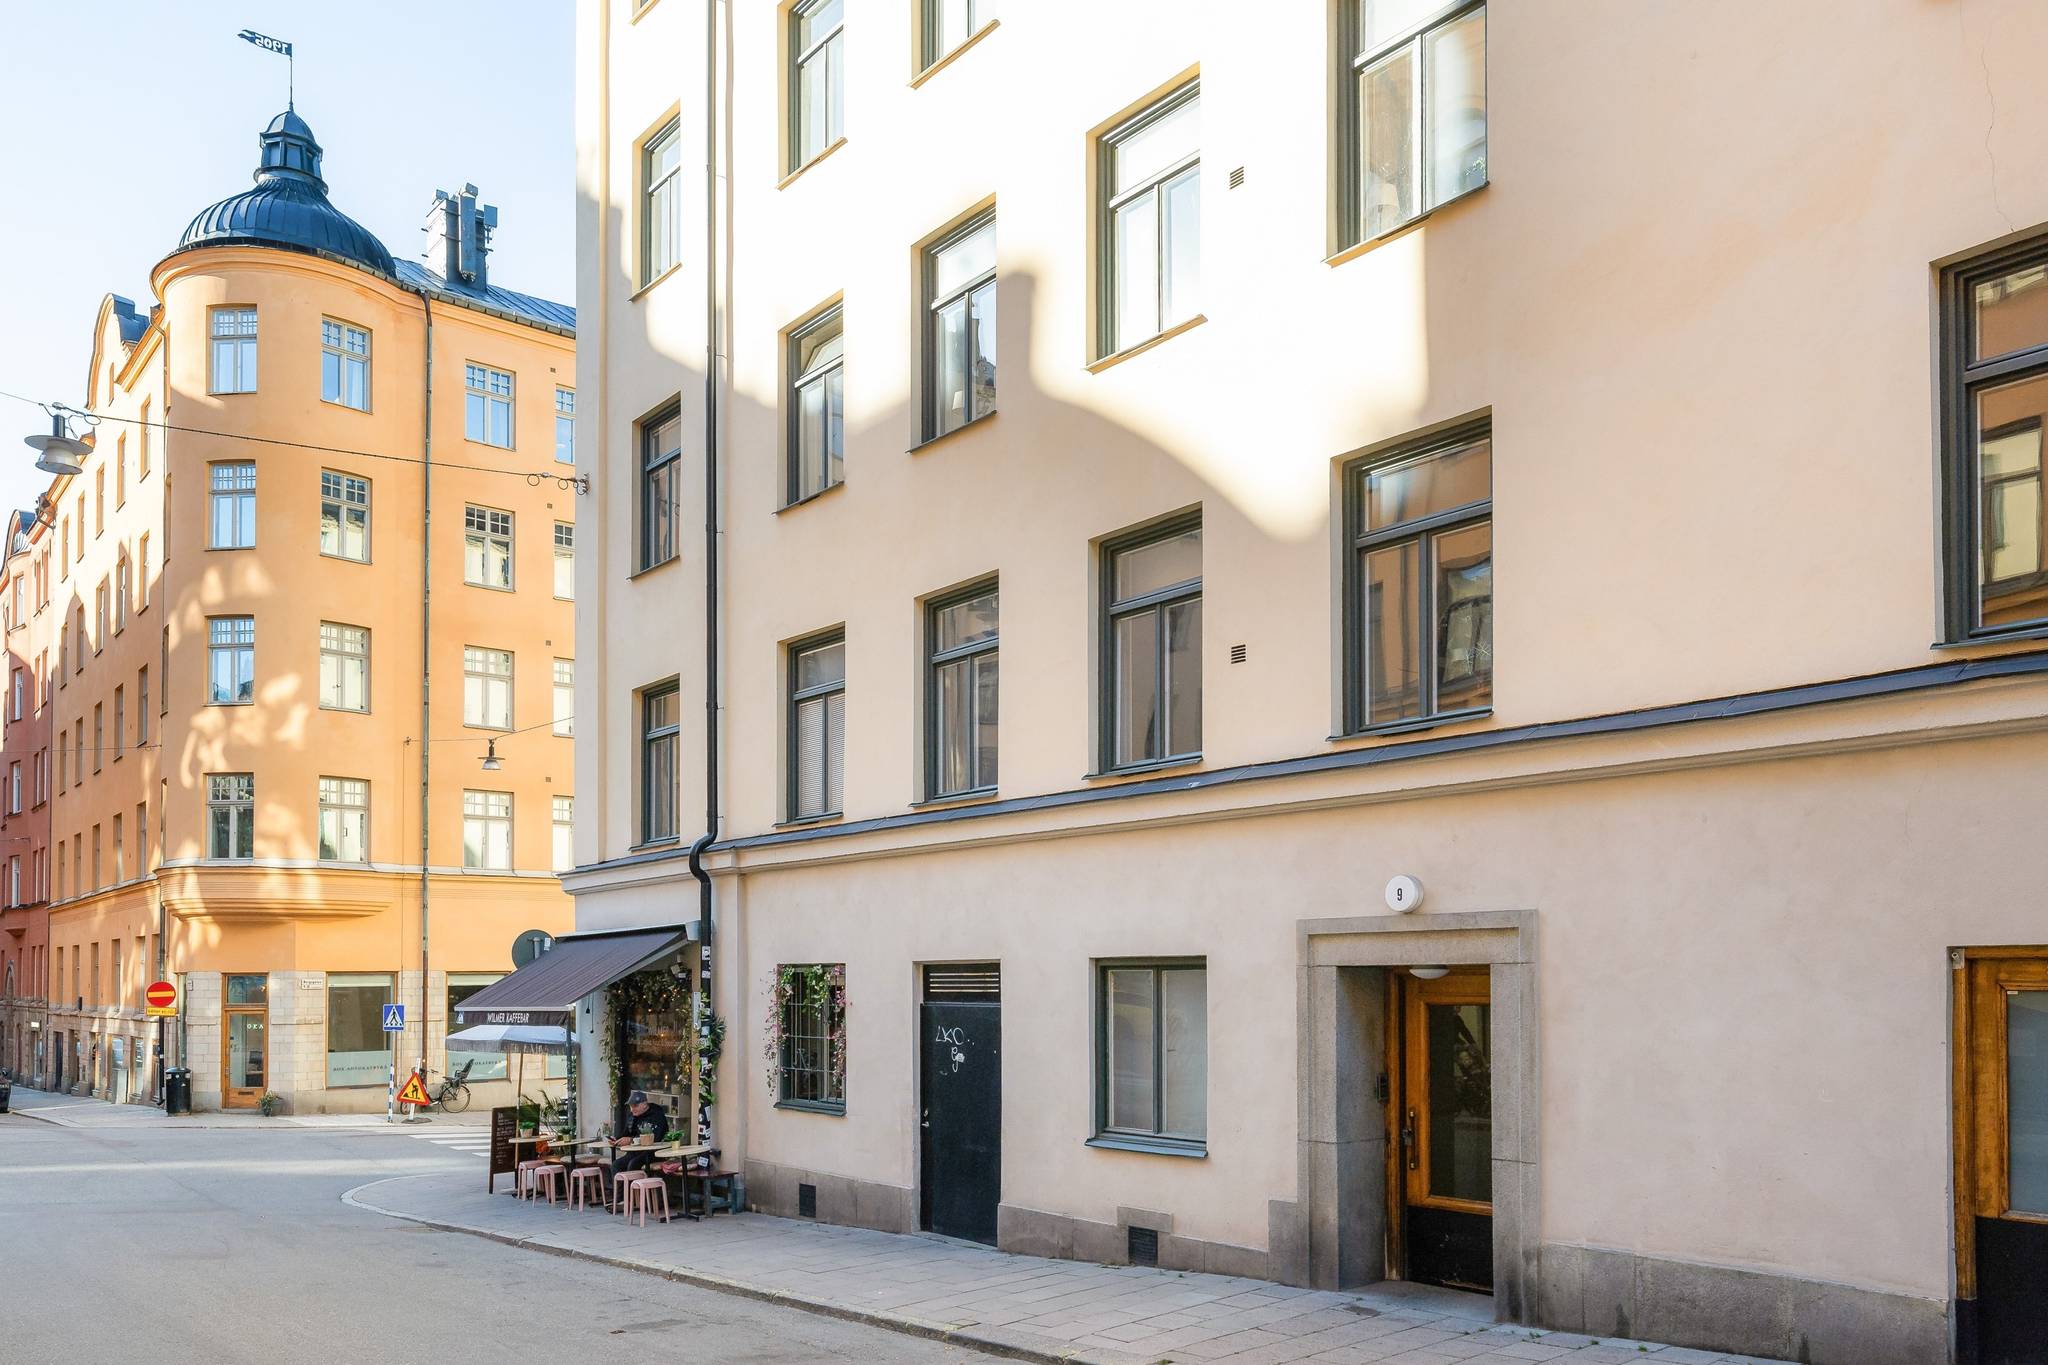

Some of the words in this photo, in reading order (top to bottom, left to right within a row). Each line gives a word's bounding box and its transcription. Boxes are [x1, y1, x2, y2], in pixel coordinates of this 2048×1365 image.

[1396, 887, 1403, 902] 9
[487, 1012, 505, 1023] WILMER
[506, 1012, 530, 1024] KAFFEBAR
